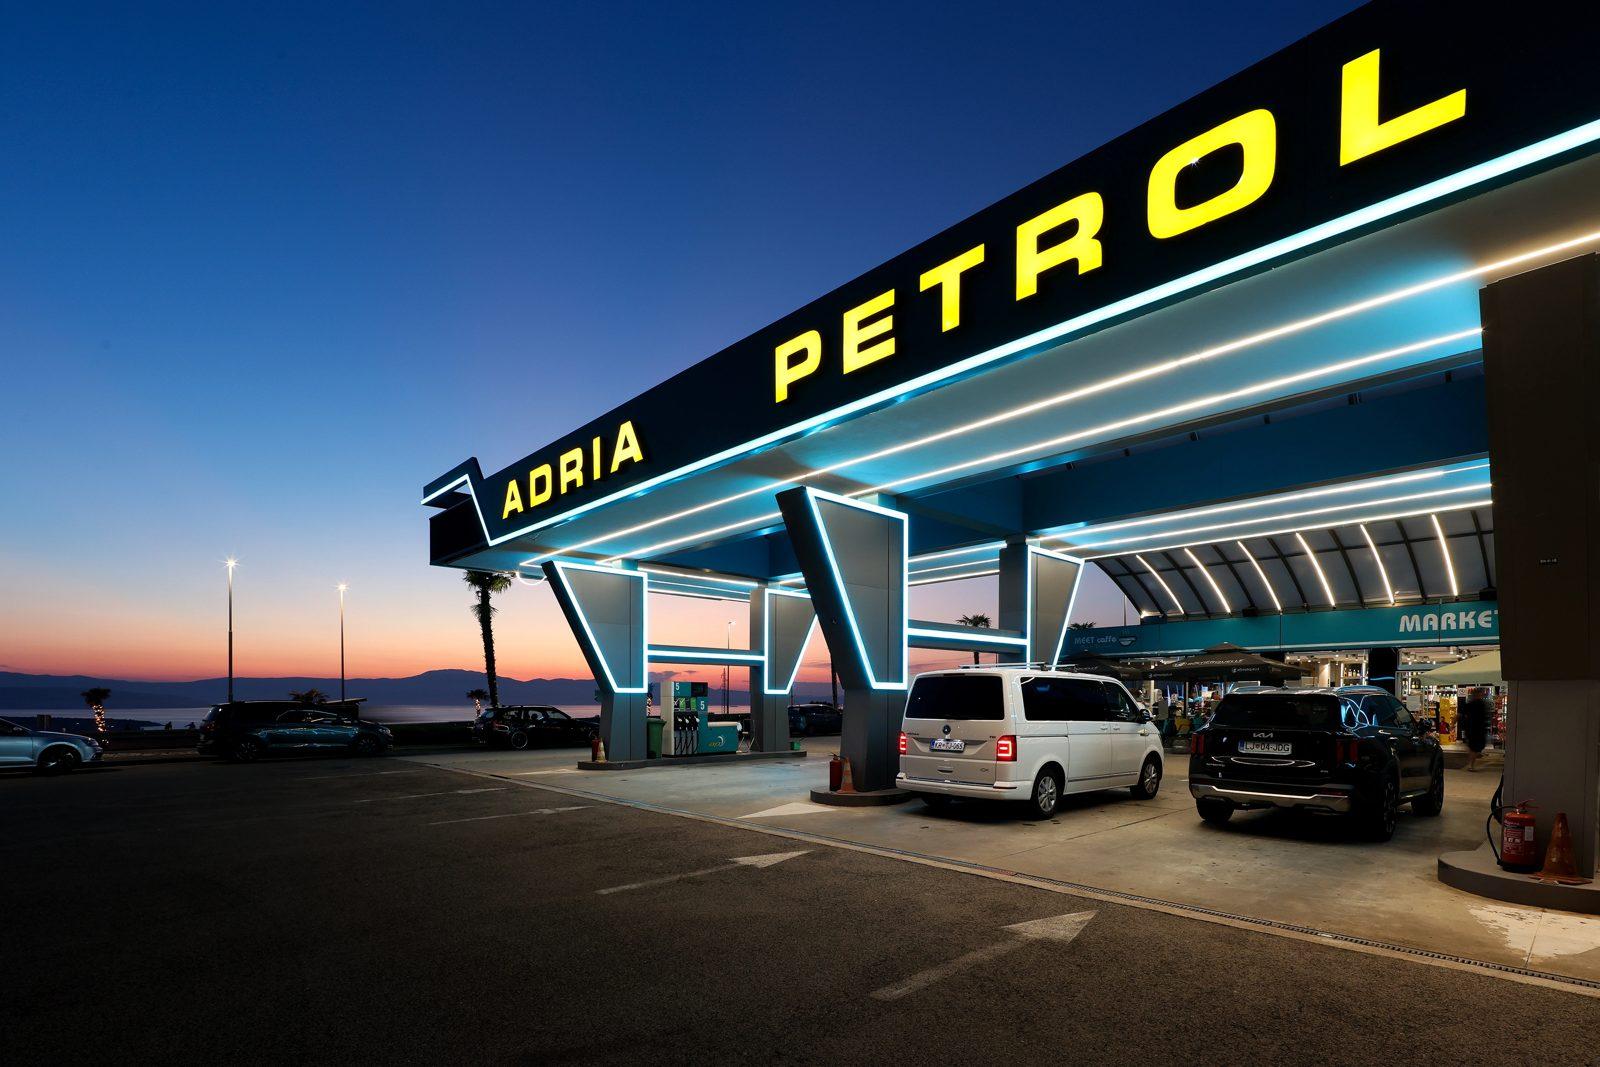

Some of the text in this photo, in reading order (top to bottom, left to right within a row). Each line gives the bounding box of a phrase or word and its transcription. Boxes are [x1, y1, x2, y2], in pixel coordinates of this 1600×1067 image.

[502, 47, 1467, 520] ADRIA PETROL
[1399, 609, 1499, 633] MARKE
[1074, 636, 1094, 645] MEET
[675, 682, 680, 691] 5
[700, 700, 705, 710] 5
